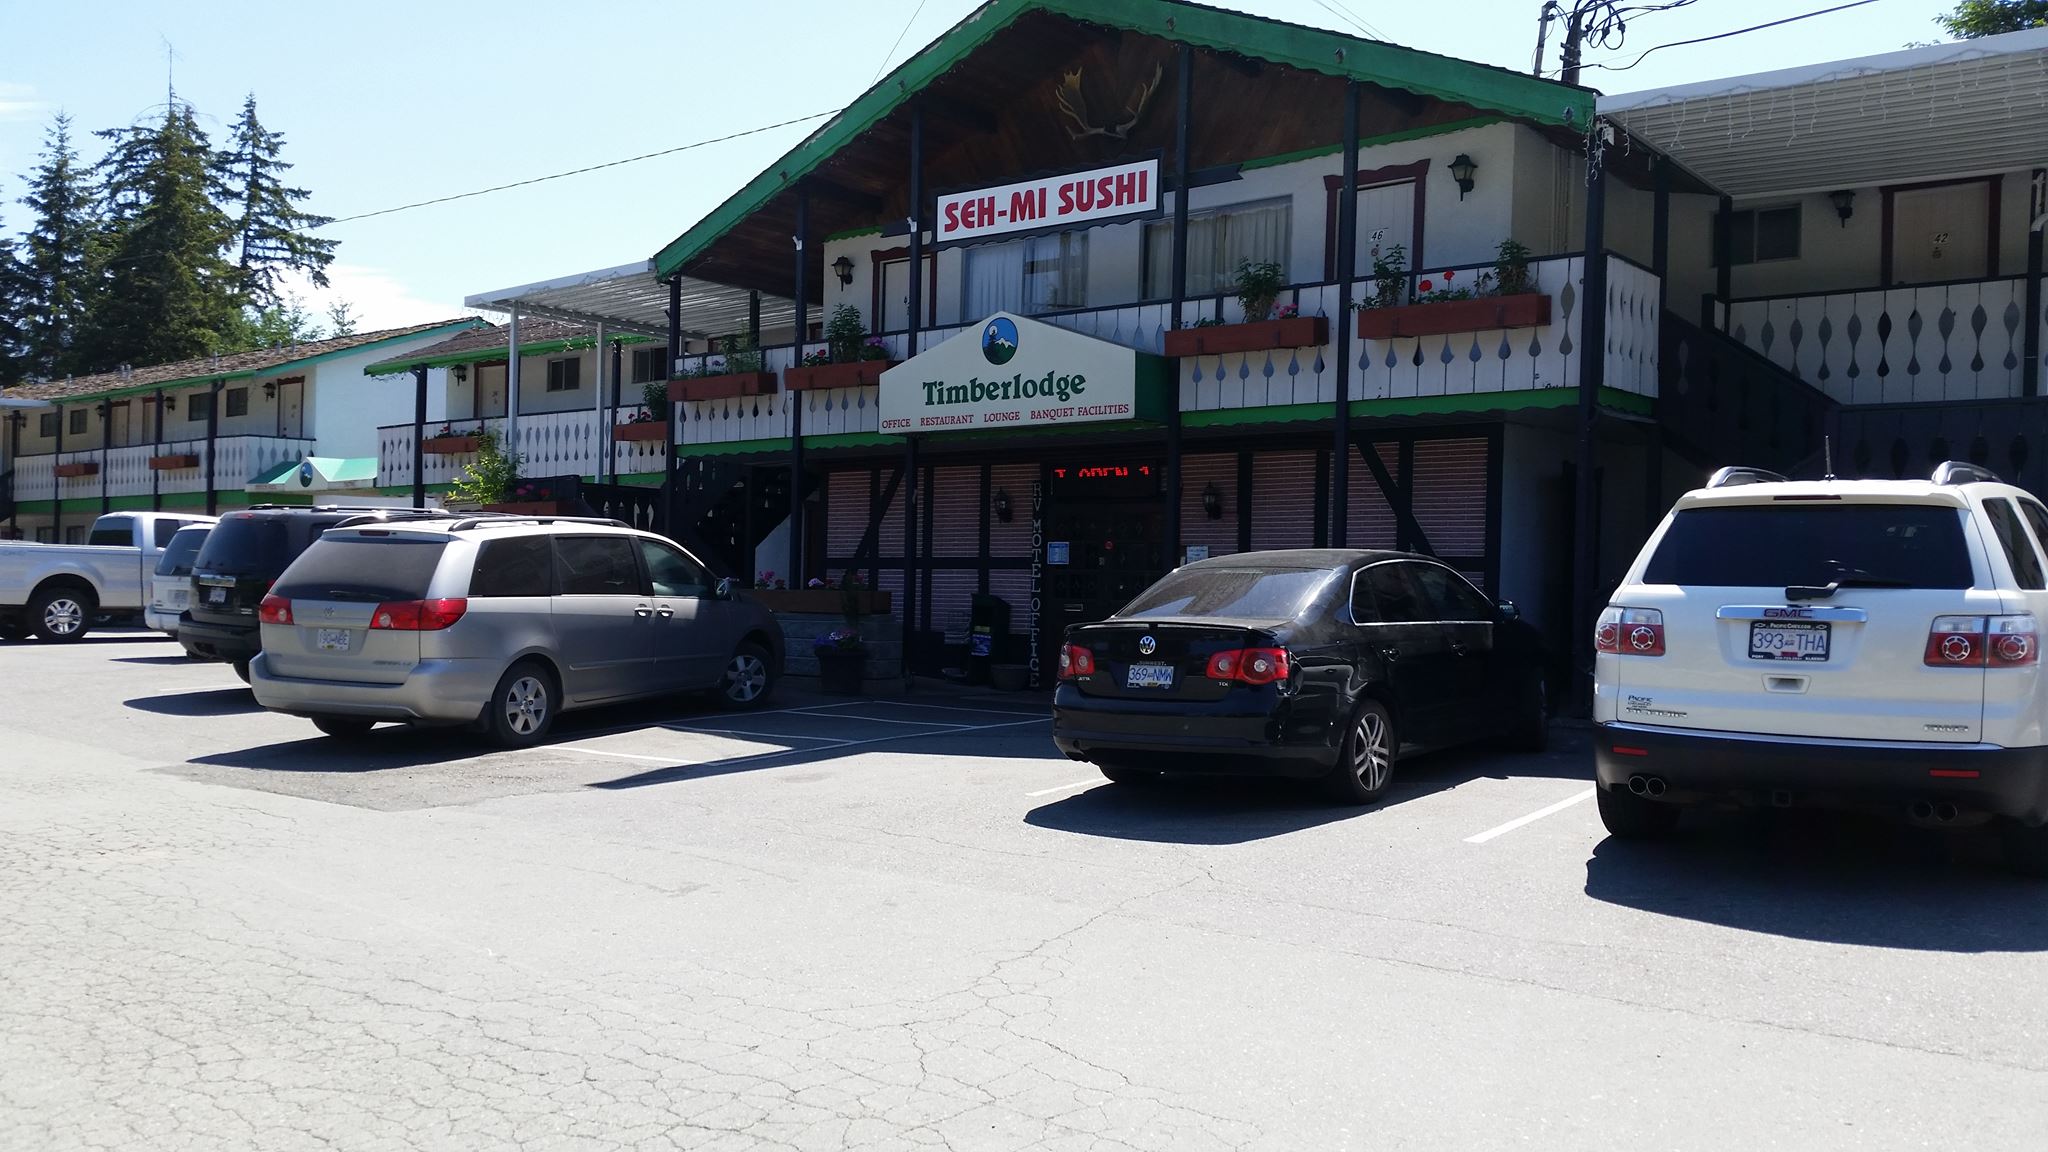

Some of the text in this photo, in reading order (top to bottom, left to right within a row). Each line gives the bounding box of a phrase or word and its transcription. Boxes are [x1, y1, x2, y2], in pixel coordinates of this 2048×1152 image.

[944, 169, 1148, 233] SEH-MI SUSHI
[1371, 230, 1384, 241] 46
[922, 369, 1087, 406] Timberlodge
[881, 403, 1130, 429] OFFICE RESTAURANT LOUNGE BANQUET FACILITIES
[1029, 482, 1042, 688] RV MOTEL OFFICE
[1764, 609, 1813, 619] GMC
[1753, 633, 1825, 651] 393 THA
[1128, 667, 1148, 681] 369
